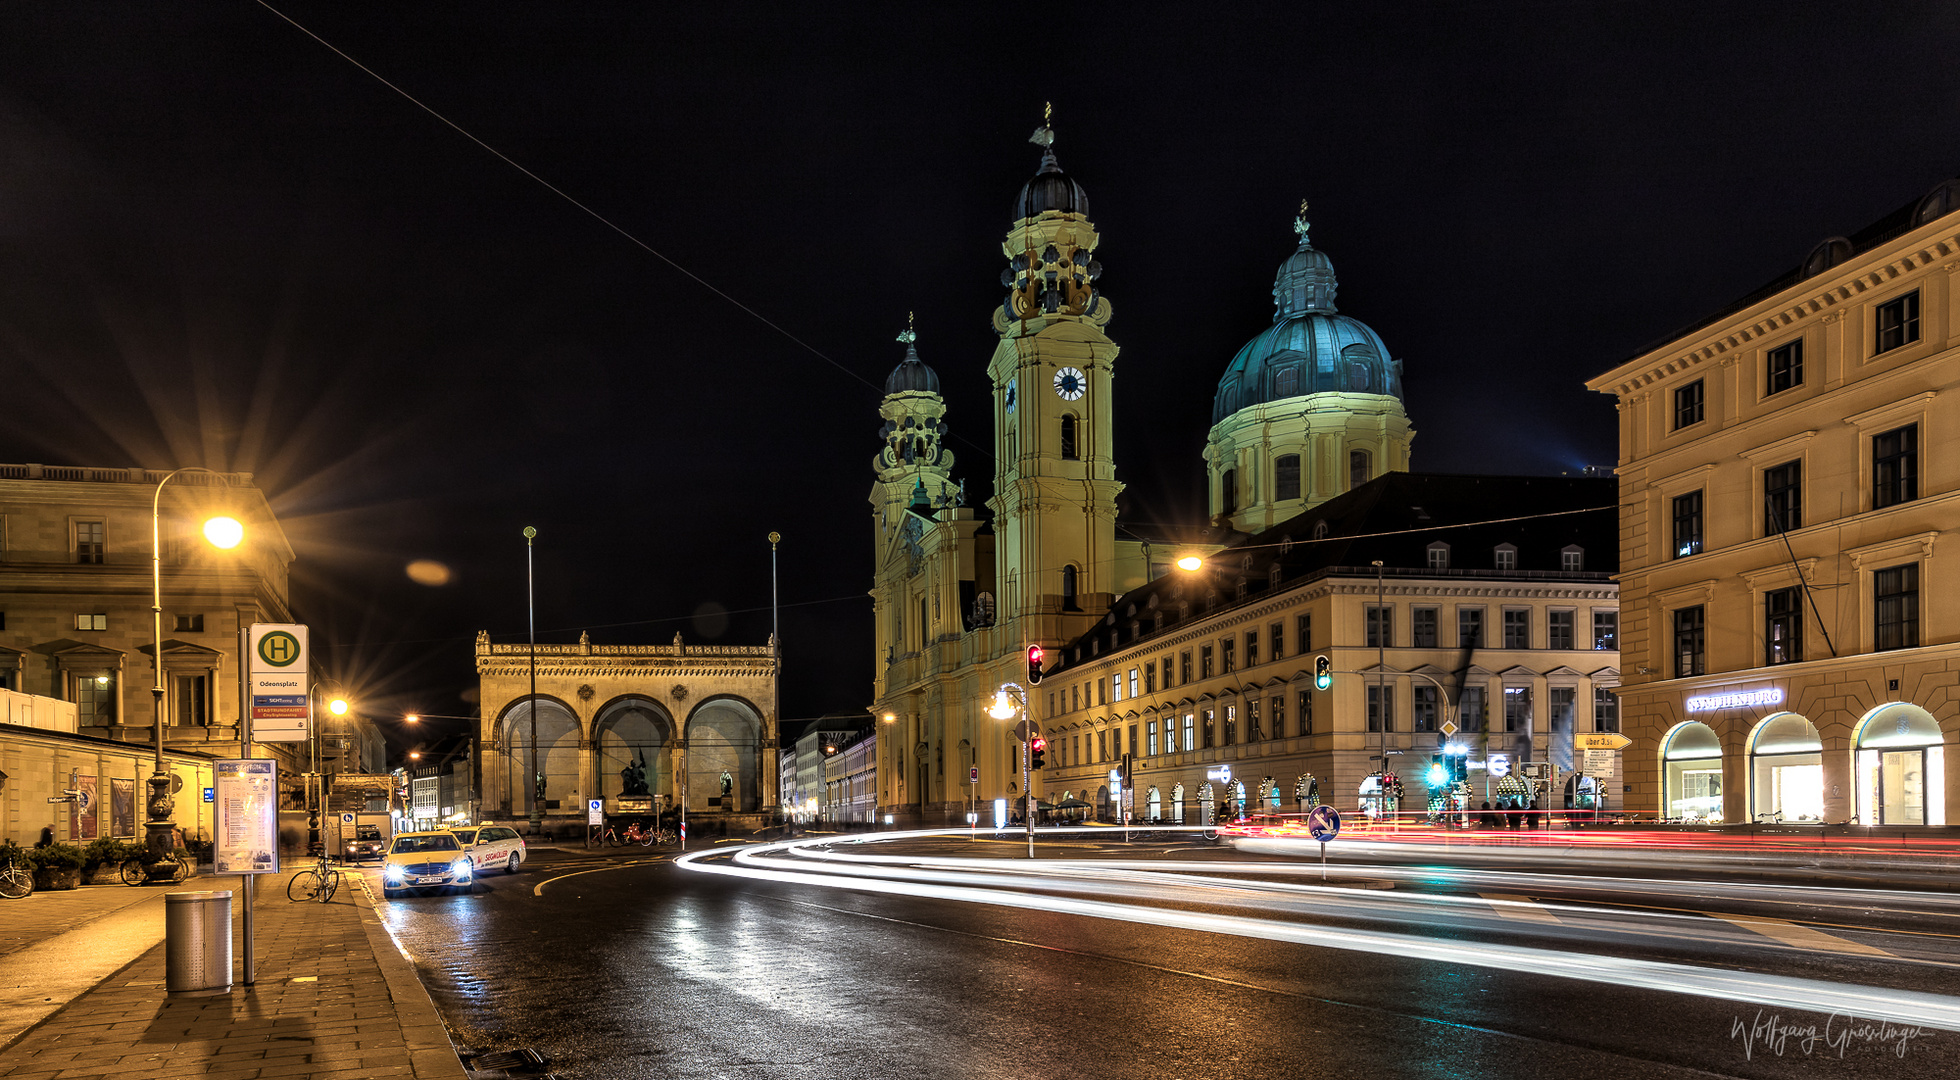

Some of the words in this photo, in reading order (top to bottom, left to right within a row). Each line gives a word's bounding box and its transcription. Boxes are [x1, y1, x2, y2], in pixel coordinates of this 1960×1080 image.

[271, 638, 288, 660] H
[1688, 690, 1780, 711] NYMPHENBURG
[1586, 737, 1600, 746] über
